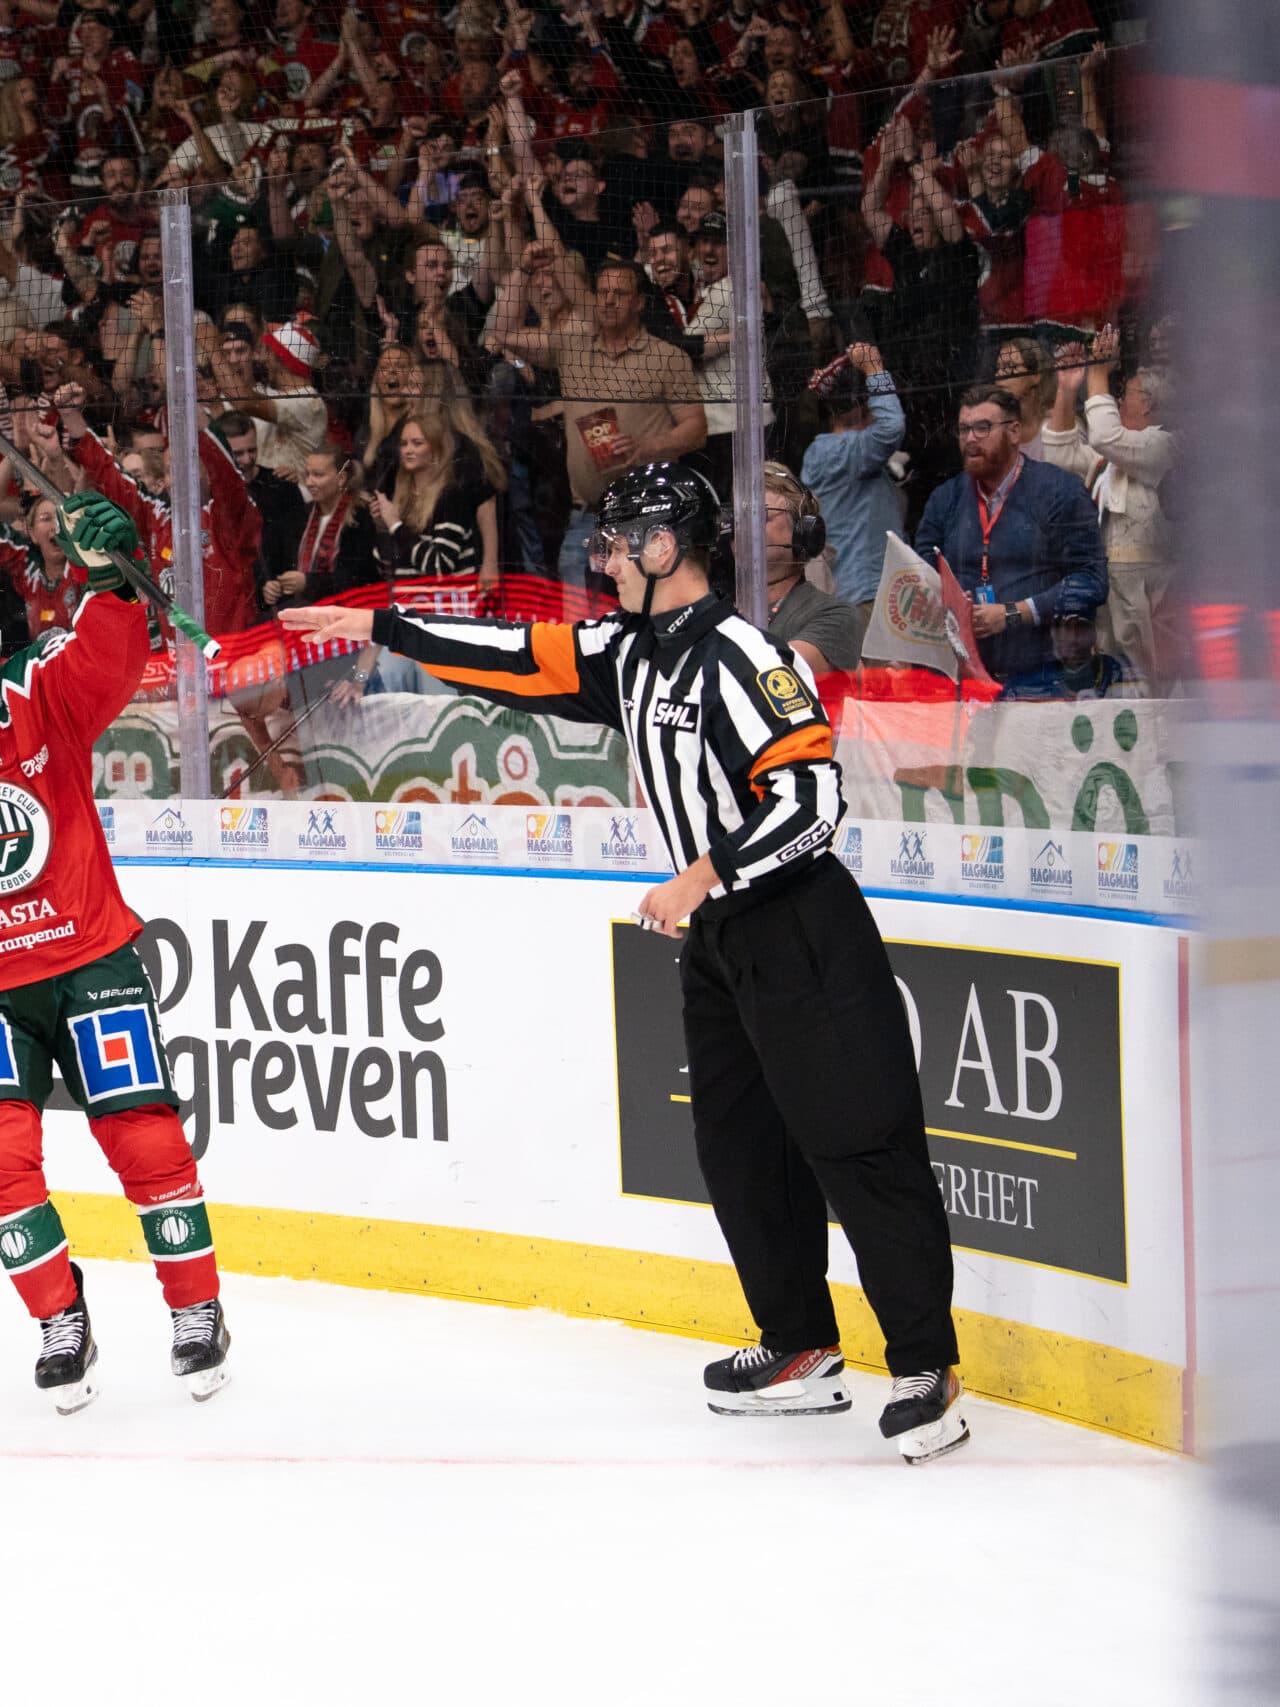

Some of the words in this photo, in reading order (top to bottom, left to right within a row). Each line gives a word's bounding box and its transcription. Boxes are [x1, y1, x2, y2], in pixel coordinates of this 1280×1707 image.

[642, 503, 672, 514] CCM
[666, 606, 694, 634] CCM
[623, 699, 635, 710] CM
[654, 701, 695, 729] SHL
[16, 794, 40, 816] CLUB
[145, 830, 193, 842] HAGMANS
[221, 830, 269, 843] HAGMANS
[298, 834, 347, 847] HAGMANS
[375, 835, 423, 848] HAGMANS
[451, 837, 498, 850] HAGMANS
[778, 821, 831, 863] CCM
[527, 838, 573, 853] HAGMANS
[601, 842, 647, 857] HAGMANS
[890, 860, 935, 876] HAGMANS
[961, 863, 1005, 879] HAGMANS
[1030, 867, 1073, 884] HAGMANS
[1098, 872, 1139, 889] HAGMANS
[212, 918, 446, 1043] Kaffe
[944, 982, 1063, 1121] AB
[165, 1034, 449, 1163] greven
[930, 1161, 1039, 1230] ERHET
[789, 1350, 821, 1379] CCM
